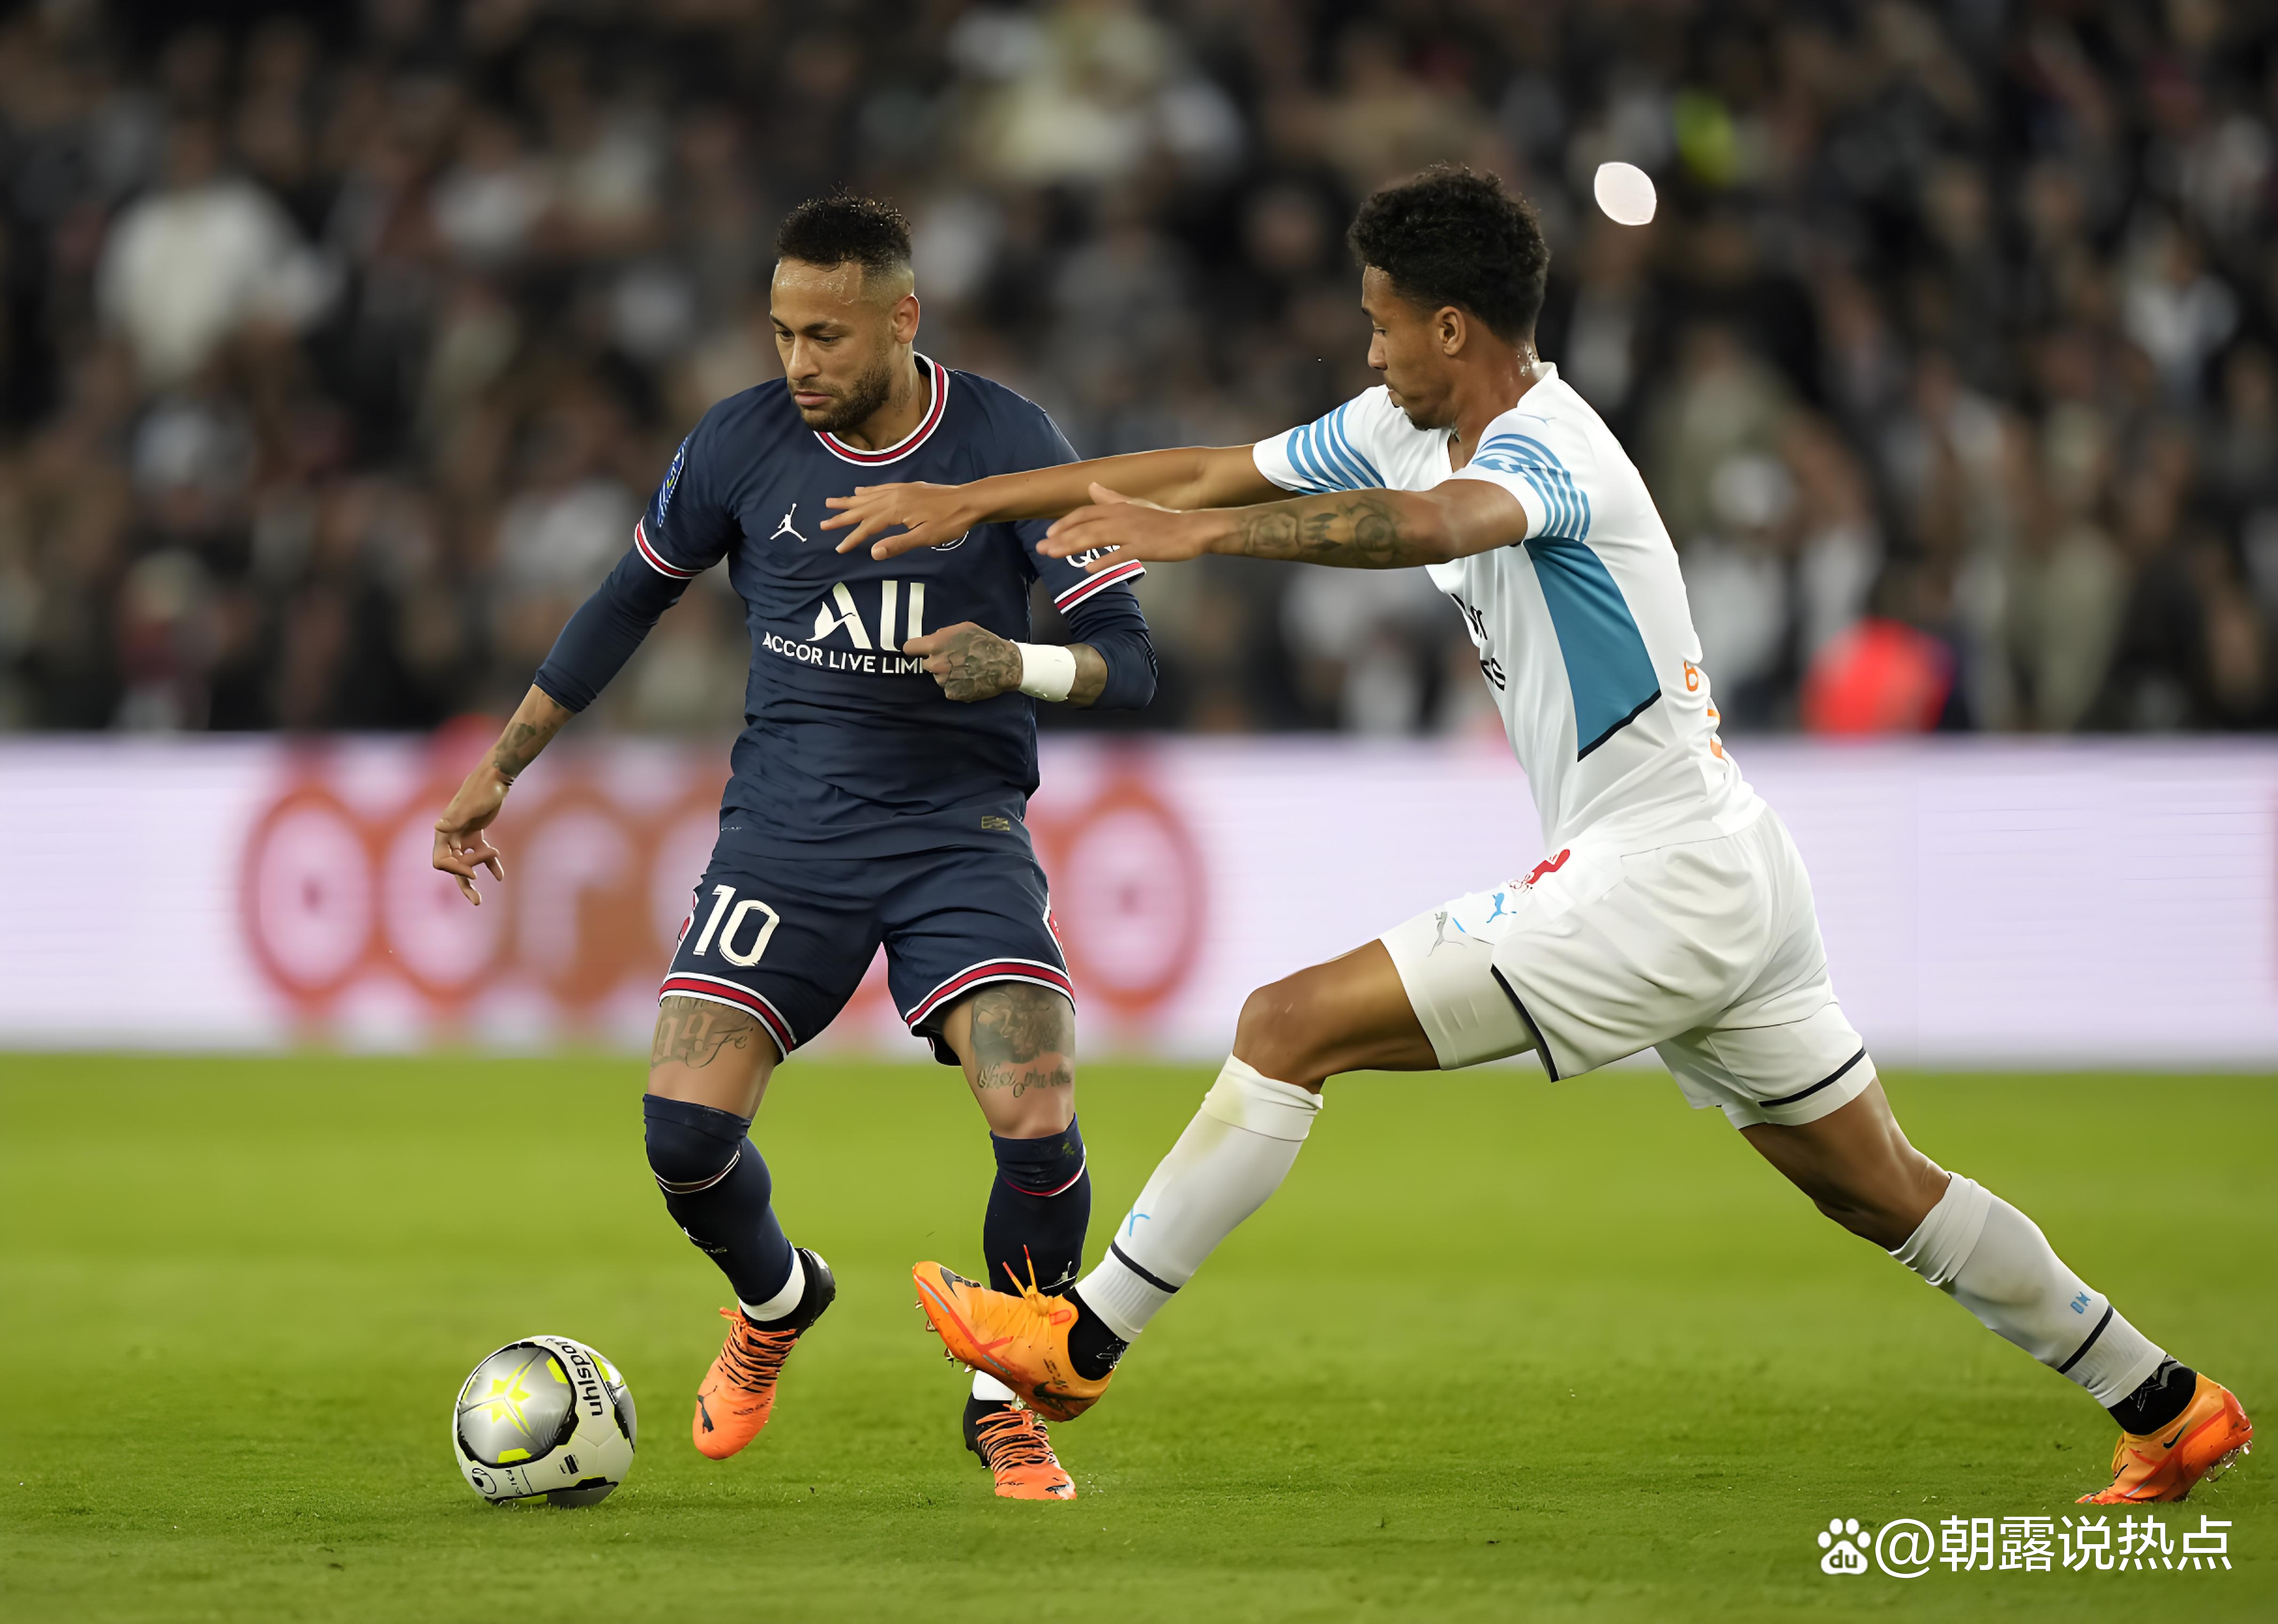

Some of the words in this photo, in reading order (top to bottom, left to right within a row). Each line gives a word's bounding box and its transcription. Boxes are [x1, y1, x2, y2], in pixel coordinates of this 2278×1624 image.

[762, 631, 823, 666] ACCOR
[829, 650, 876, 672] LIVE
[882, 657, 923, 674] LIMI
[693, 884, 780, 967] 10
